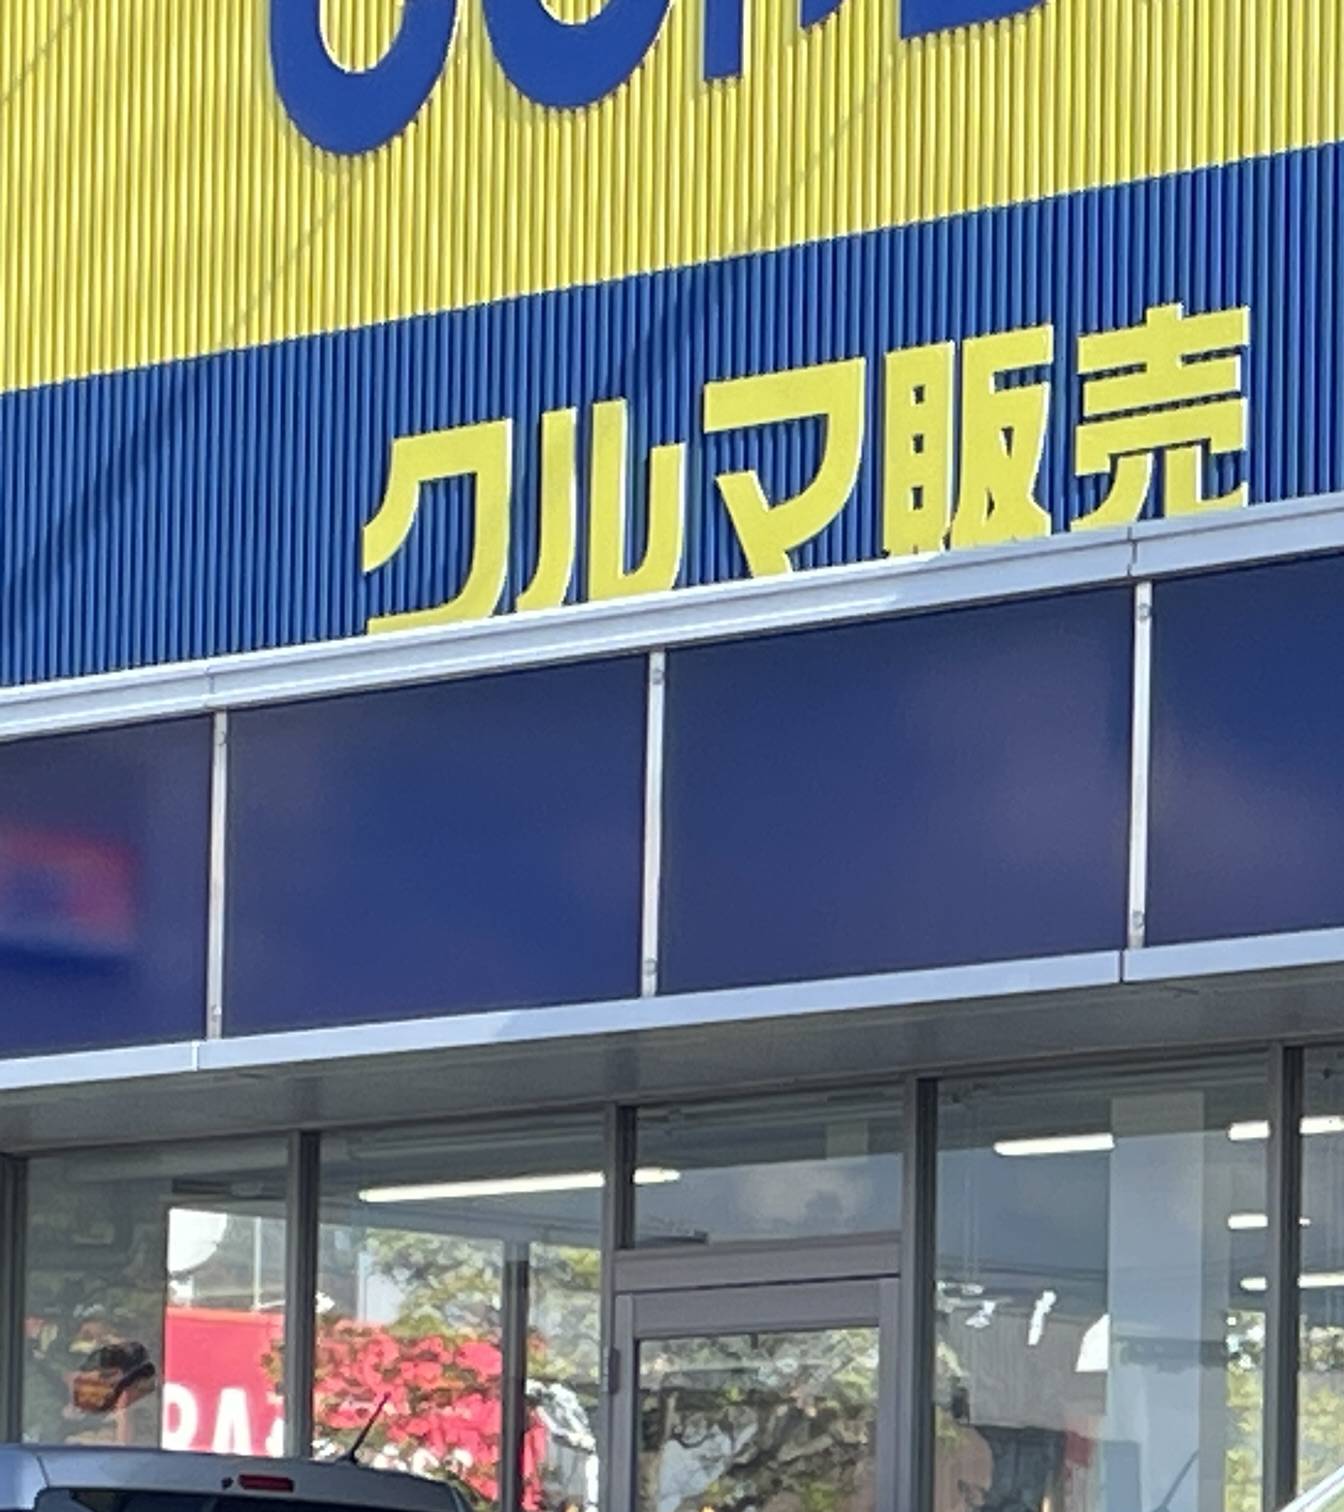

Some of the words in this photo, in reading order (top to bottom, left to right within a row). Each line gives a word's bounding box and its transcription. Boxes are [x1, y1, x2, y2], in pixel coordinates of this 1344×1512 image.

[362, 303, 1251, 635] クルマ販売
